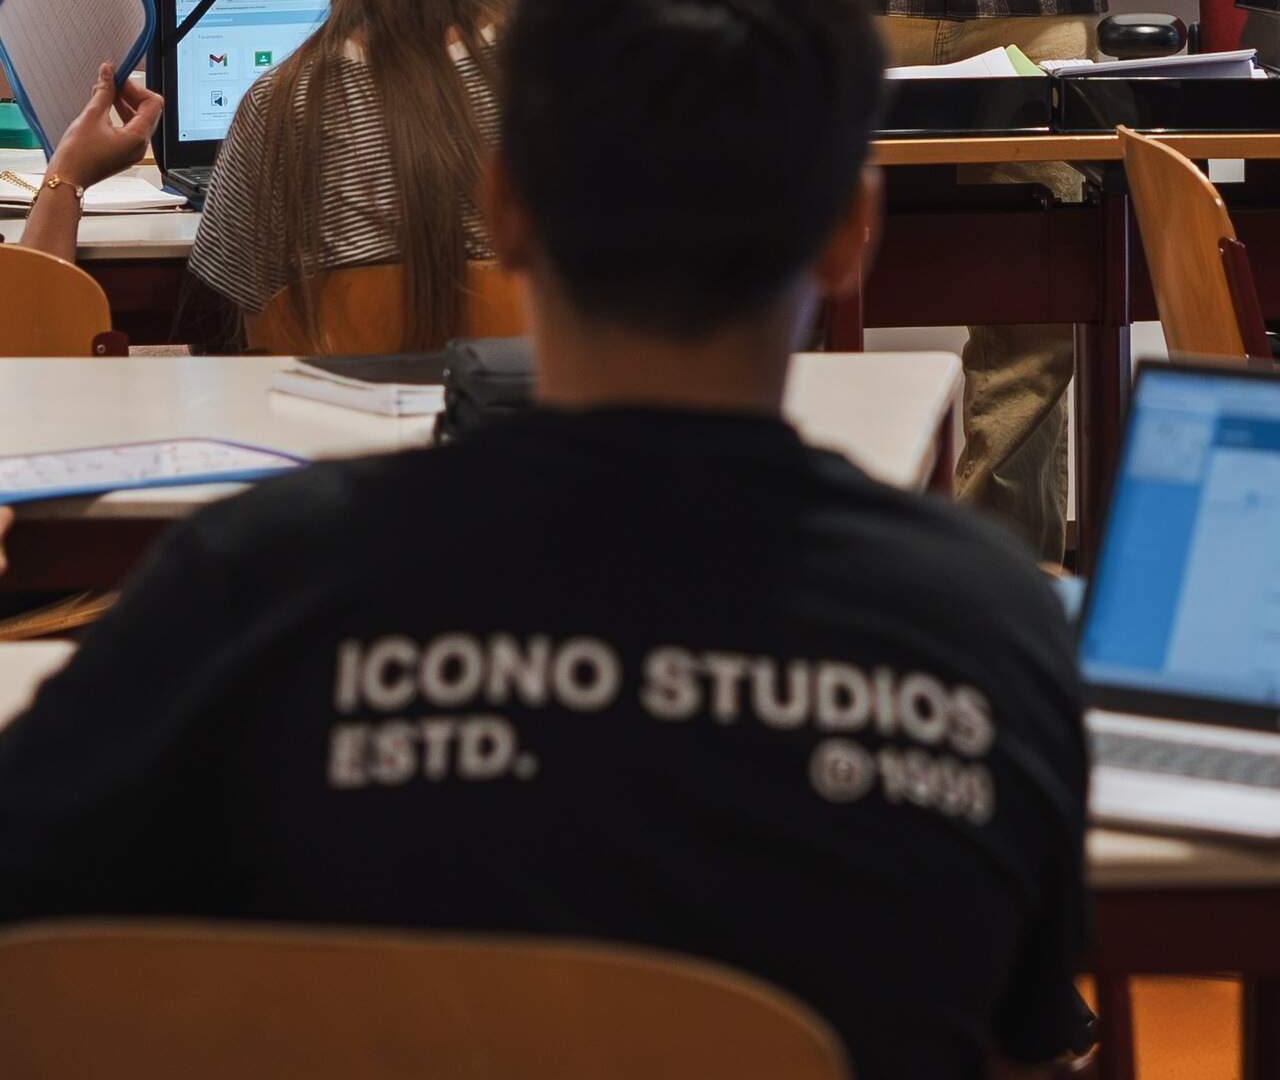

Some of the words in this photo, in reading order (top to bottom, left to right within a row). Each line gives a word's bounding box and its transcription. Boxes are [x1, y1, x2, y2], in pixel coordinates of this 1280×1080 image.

[335, 633, 622, 713] ICONO
[641, 647, 995, 757] STUDIOS
[330, 717, 538, 788] ESTD.
